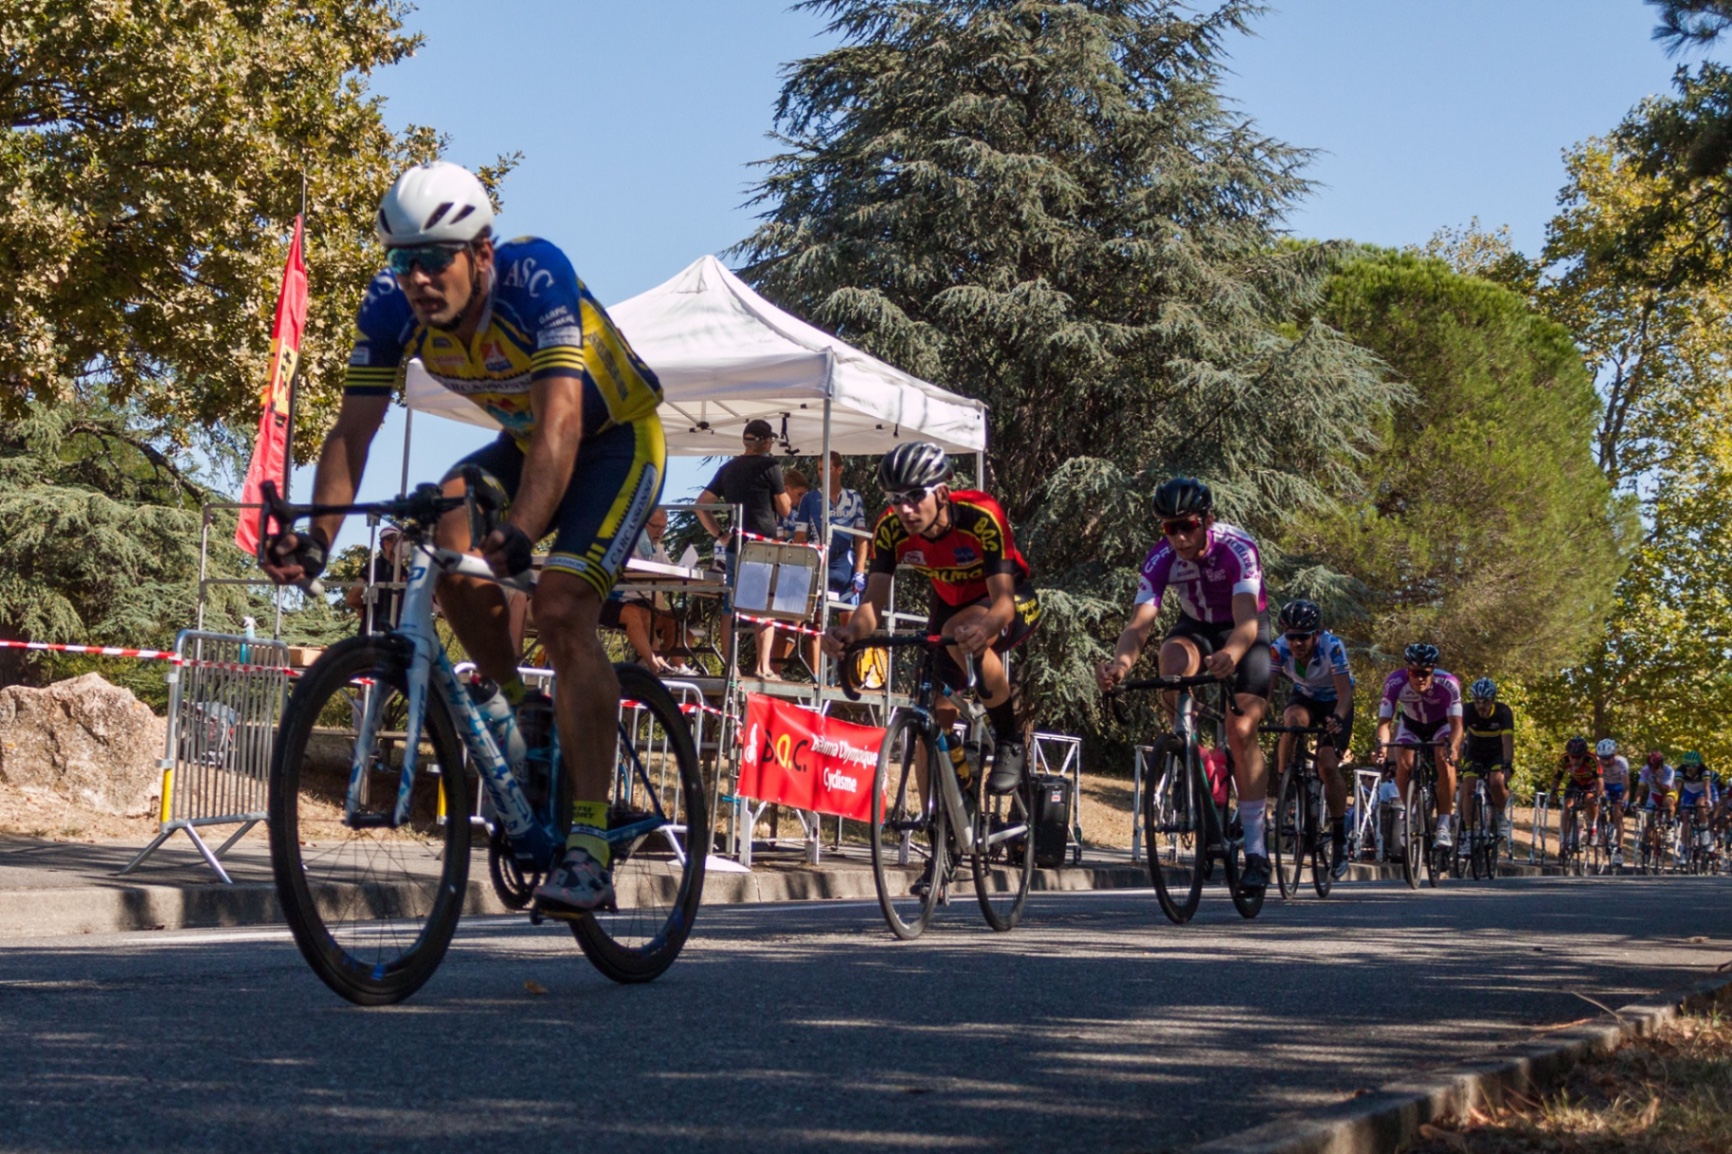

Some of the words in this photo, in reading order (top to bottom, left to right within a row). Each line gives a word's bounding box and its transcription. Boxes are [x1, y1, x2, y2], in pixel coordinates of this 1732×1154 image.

[503, 257, 555, 298] ASC
[811, 733, 838, 758] Balma
[838, 739, 879, 769] Olympique
[823, 767, 858, 793] Cyclisme
